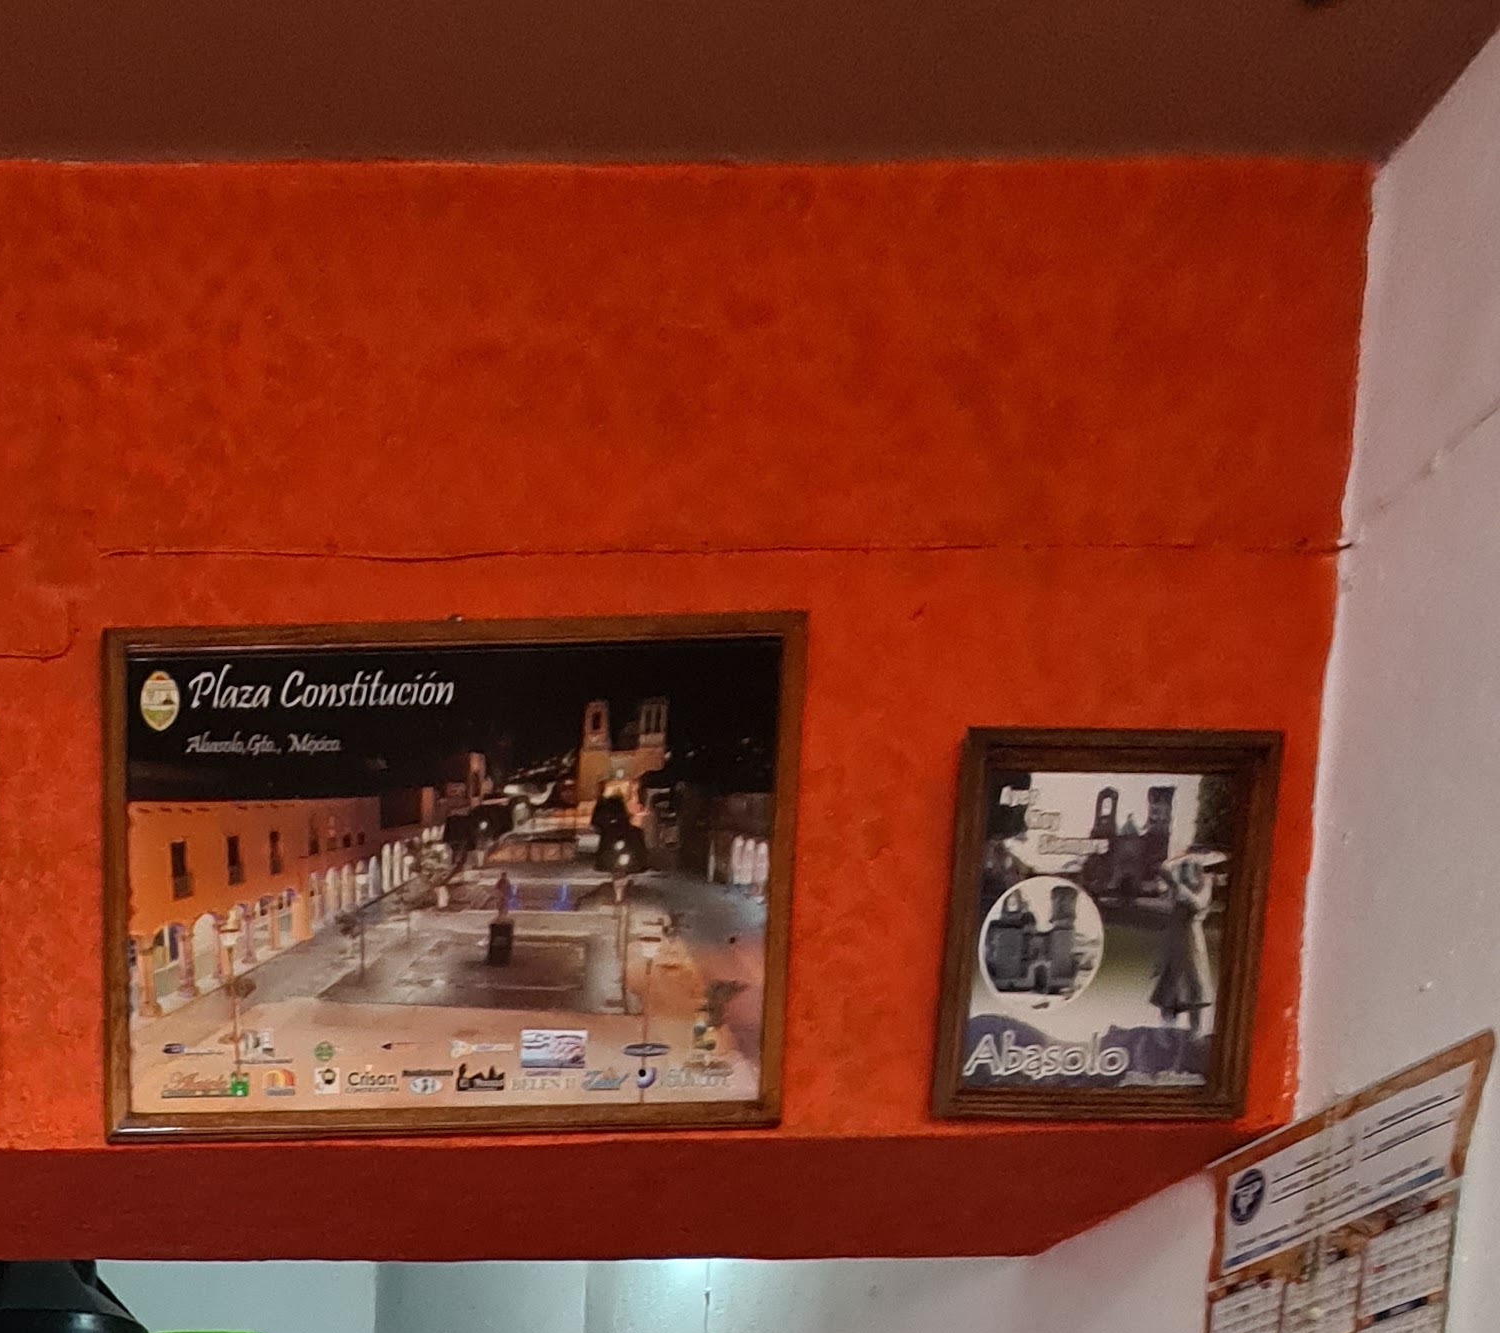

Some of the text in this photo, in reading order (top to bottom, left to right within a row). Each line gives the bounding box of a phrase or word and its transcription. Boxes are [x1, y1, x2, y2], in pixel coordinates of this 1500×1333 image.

[189, 664, 455, 709] Plaza Constitución
[962, 1029, 1130, 1080] Abasolo
[348, 1070, 397, 1086] Crisan
